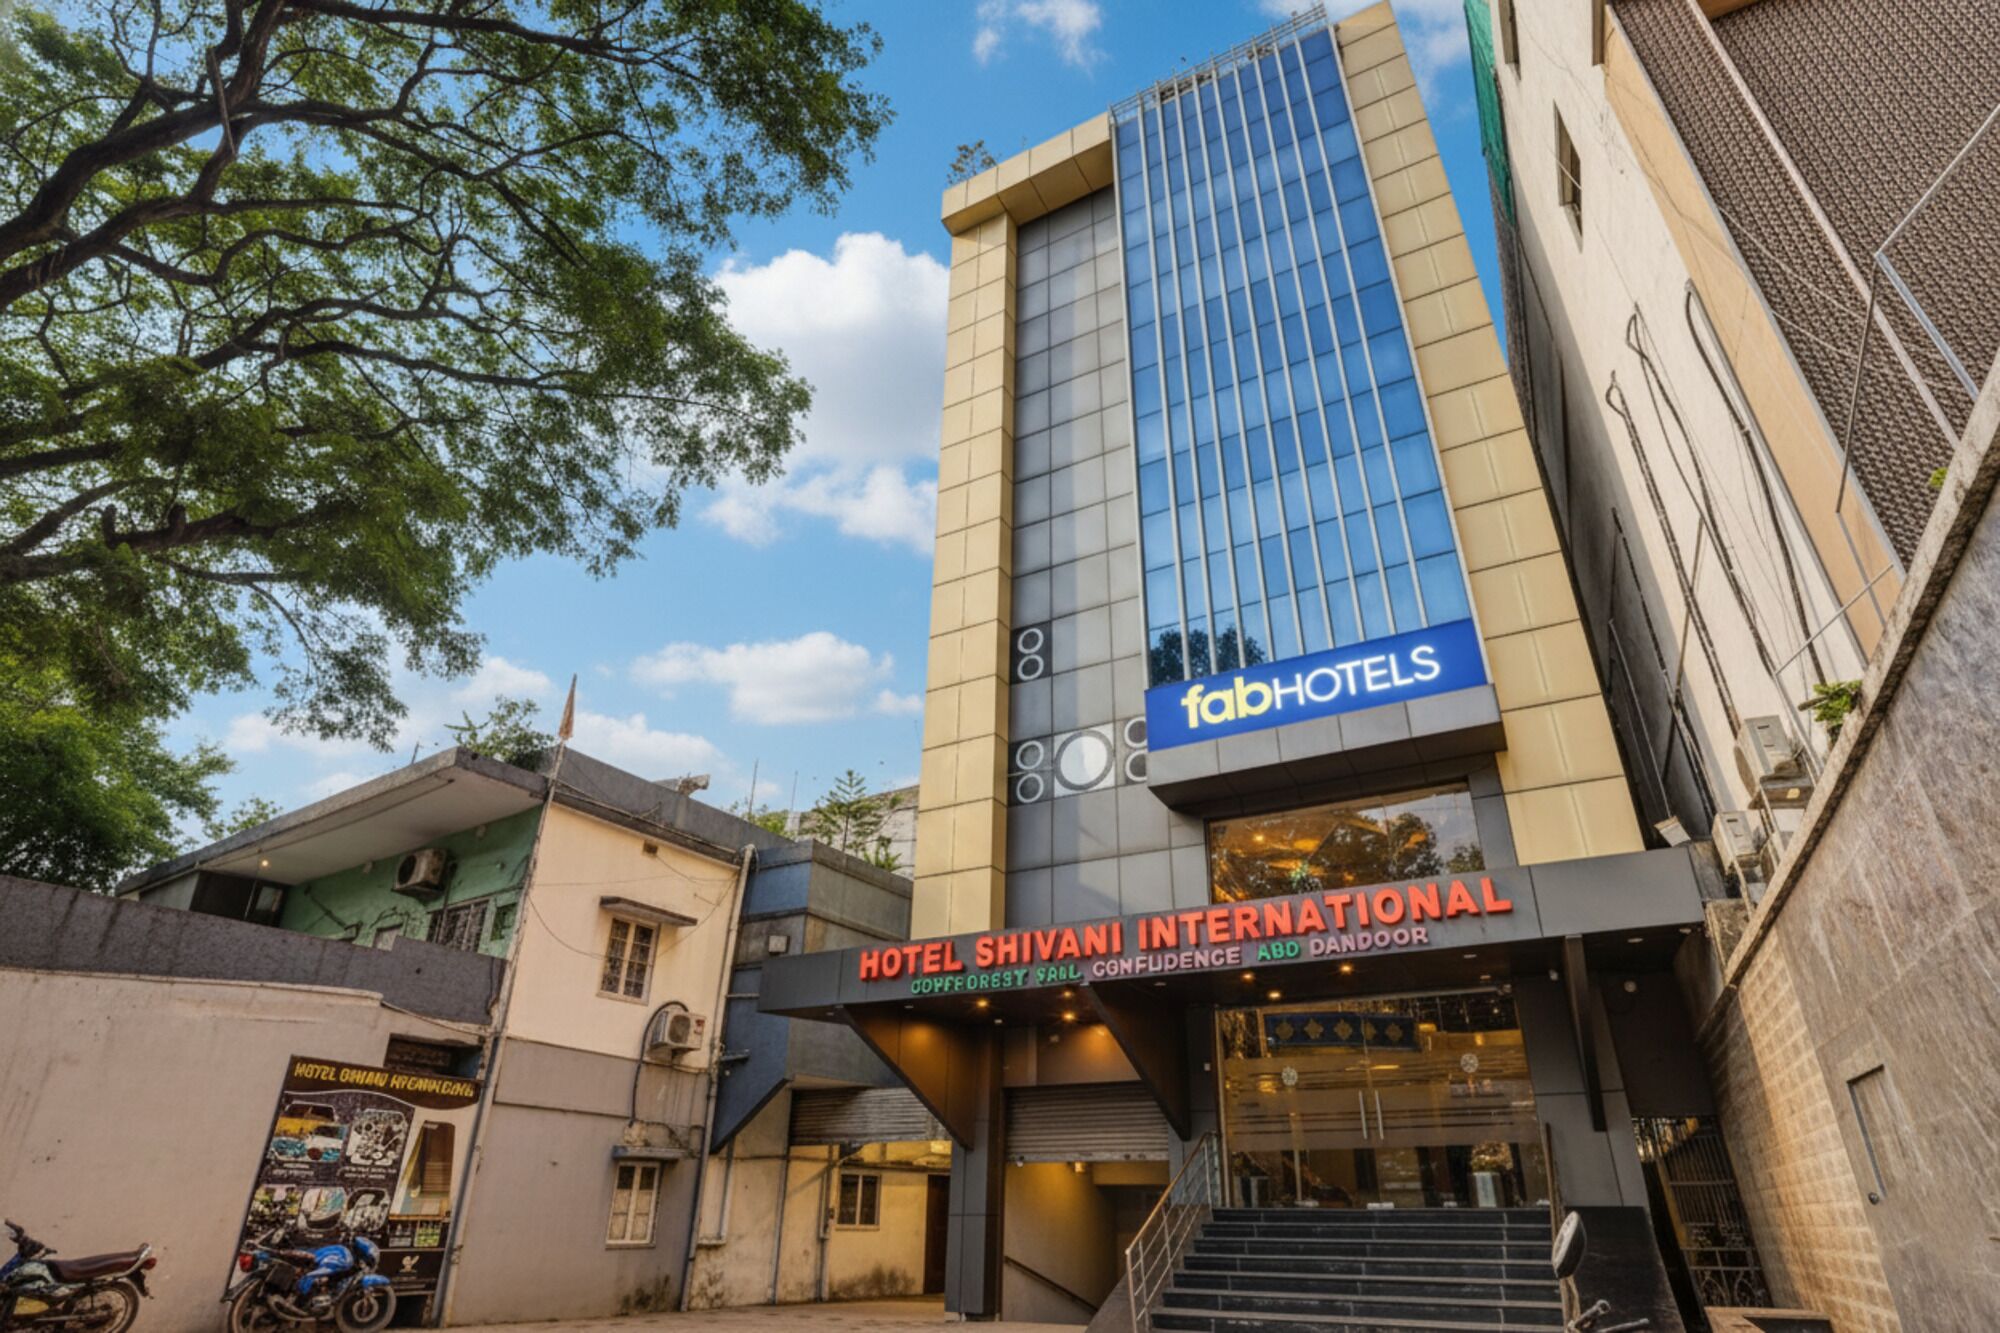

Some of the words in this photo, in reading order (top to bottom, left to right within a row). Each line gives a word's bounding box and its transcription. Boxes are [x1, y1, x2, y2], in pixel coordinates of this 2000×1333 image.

[1181, 645, 1441, 729] fabHOTELS
[859, 941, 964, 980] HOTEL
[975, 921, 1123, 968] SHIVANI
[1138, 876, 1513, 950] INTERNATIONAL
